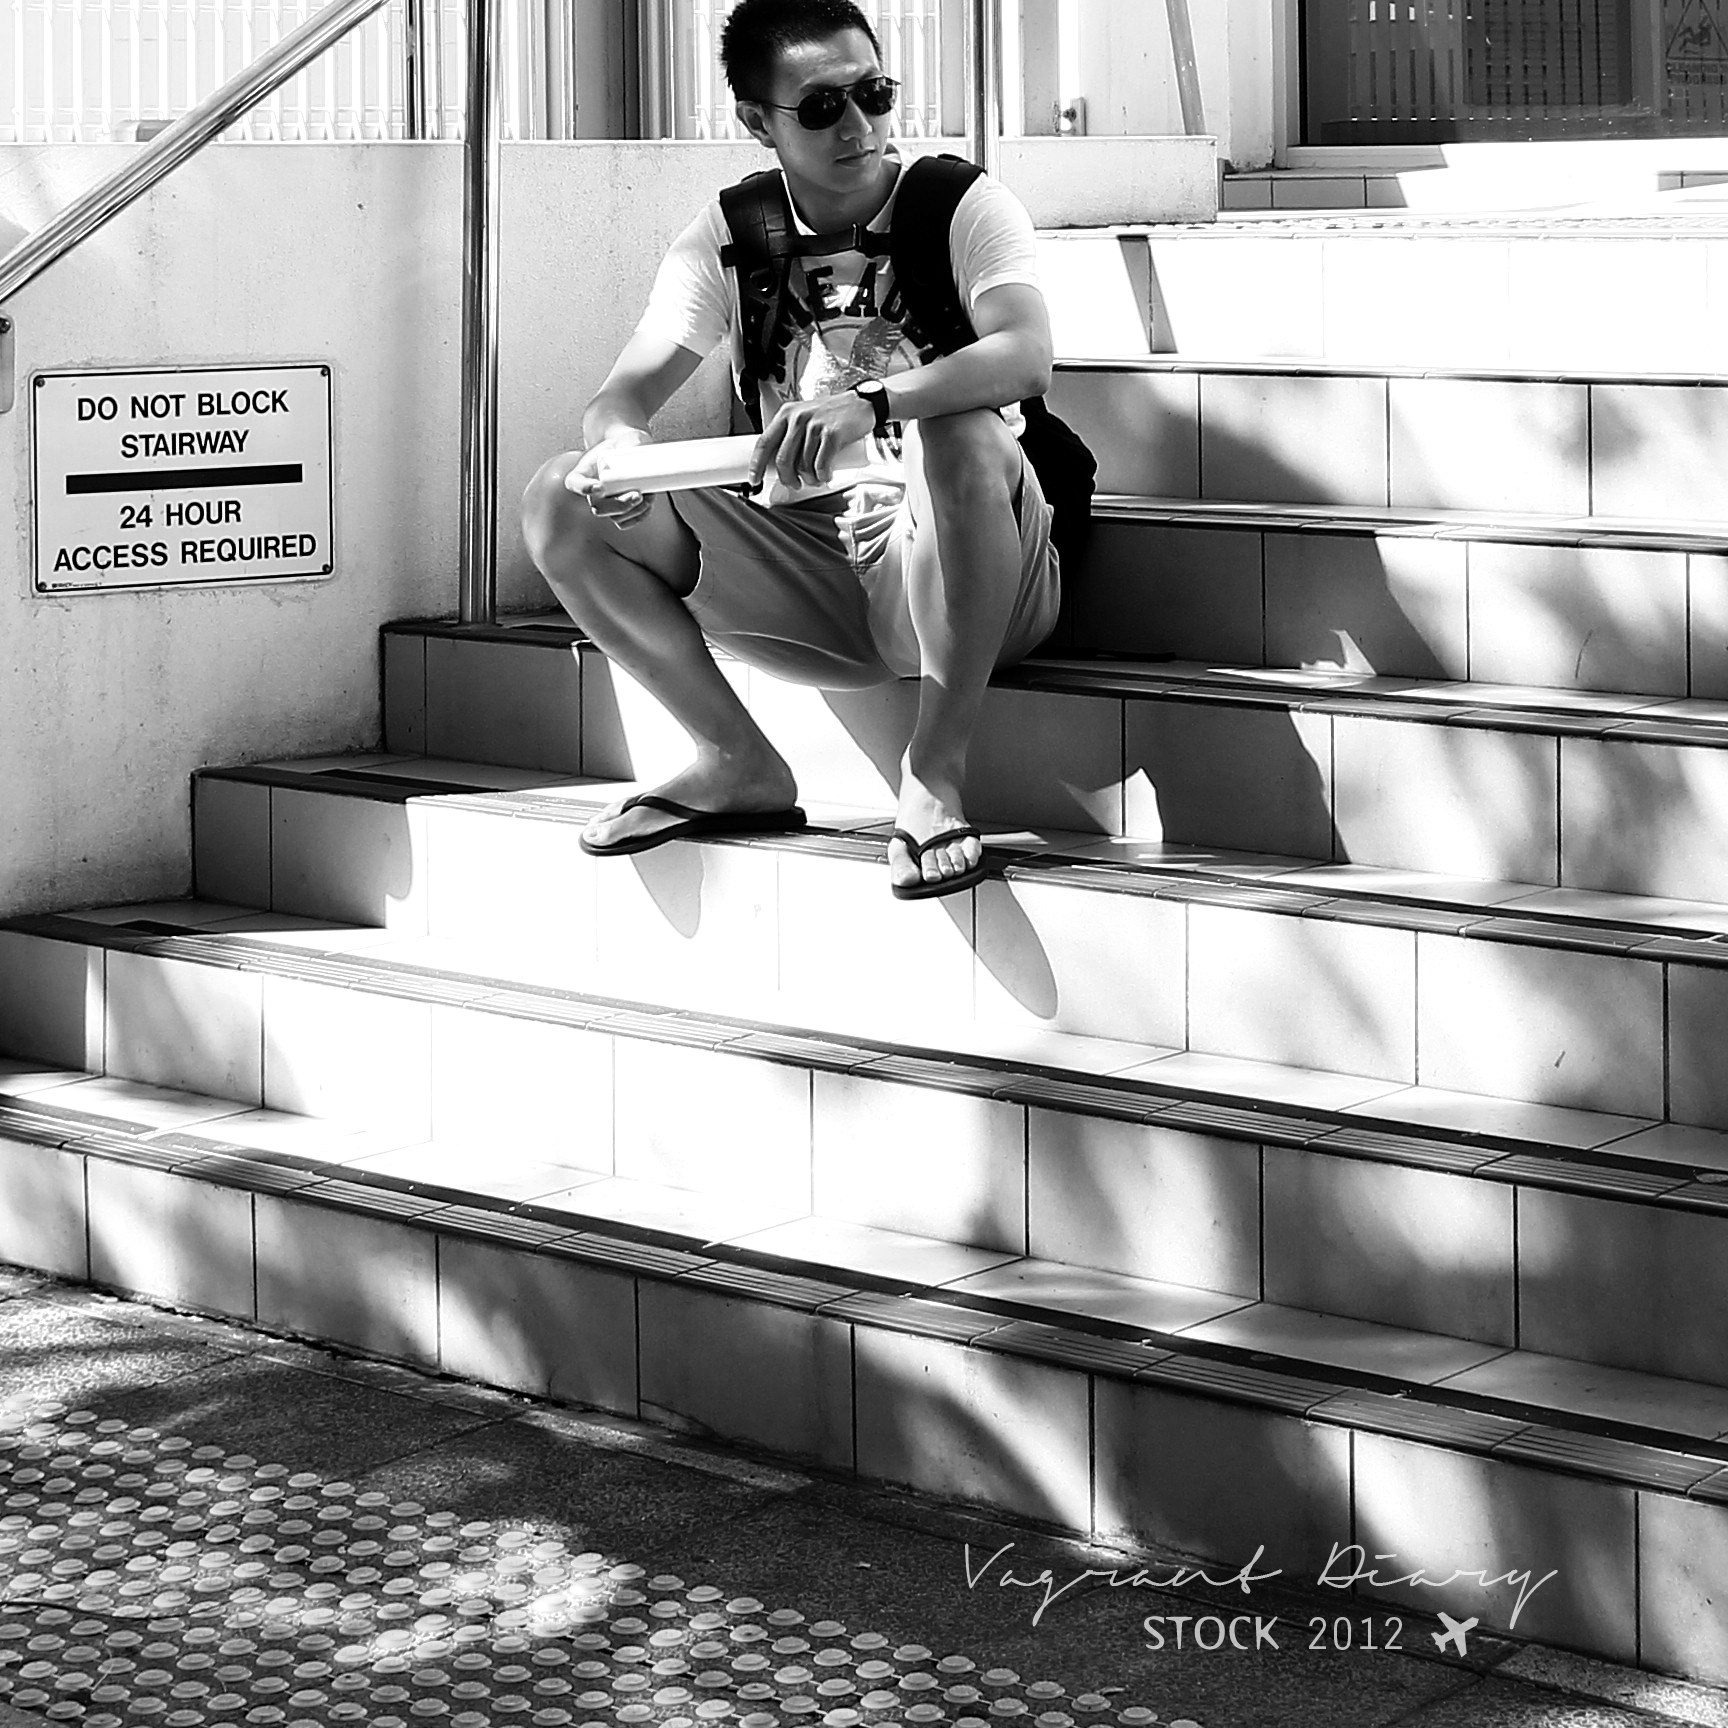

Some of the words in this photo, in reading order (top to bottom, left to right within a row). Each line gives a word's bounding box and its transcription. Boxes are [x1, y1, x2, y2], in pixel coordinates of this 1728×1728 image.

[77, 396, 118, 421] DO
[131, 394, 186, 419] NOT
[197, 389, 289, 416] BLOCK
[121, 429, 249, 459] STAIRWAY
[120, 504, 153, 529] 24
[166, 500, 242, 527] HOUR
[53, 541, 168, 572] ACCESS
[181, 533, 317, 564] REQUIRED
